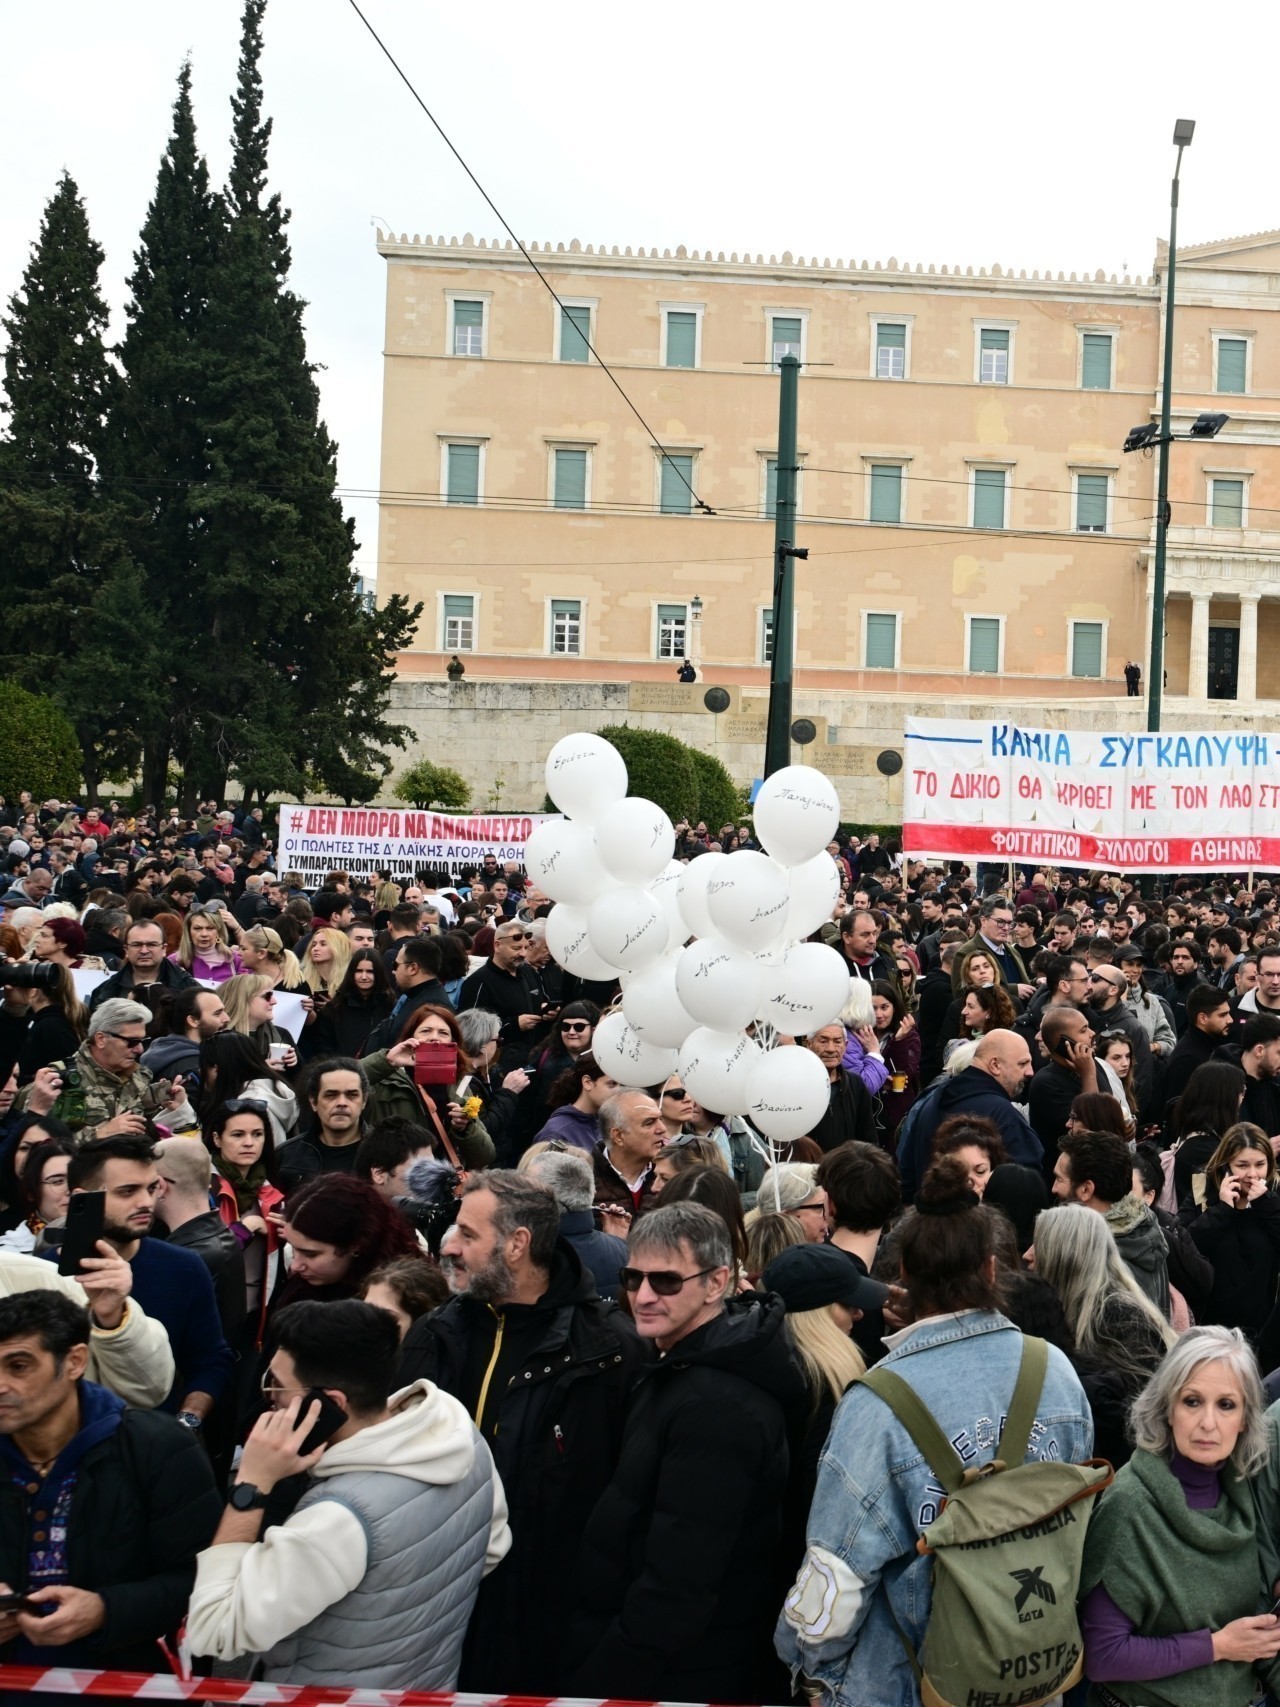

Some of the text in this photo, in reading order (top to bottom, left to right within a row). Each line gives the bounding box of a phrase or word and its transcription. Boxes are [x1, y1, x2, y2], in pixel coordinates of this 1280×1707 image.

[991, 725, 1268, 768] ΚΑΜΙΑ ΣΥΓΚΑΛΥΨΗ
[774, 788, 834, 812] Παναγιώτης
[912, 770, 938, 797] ΤΟ
[950, 773, 1001, 799] ΔΙΚΙΟ
[1018, 775, 1042, 800] ΘΑ
[1057, 782, 1112, 810] ΚΡΙΘΕΙ
[1130, 785, 1157, 810] ΜΕ
[1171, 785, 1208, 809] ΤΟΝ
[1219, 784, 1252, 809] ΛΑΟ
[305, 809, 338, 835] ΔΕΝ
[341, 811, 400, 838] ΜΠΟΡΩ
[404, 813, 428, 839] ΝΑ
[430, 814, 533, 842] ΑΝΑΠΝΕΥΣΩ
[285, 838, 298, 851] ΟΙ
[301, 839, 354, 854] ΠΩΛΗΤΕΣ
[357, 842, 380, 855] ΤΗΣ
[397, 841, 443, 857] ΛΑΪΚΗΣ
[446, 845, 495, 859] ΑΓΟΡΑΣ
[991, 831, 1262, 863] ΦΟΙΤΗΤΙΚΟΙ ΣΥΛΛΟΓΟΙ ΑΘΗΝΑΣ
[288, 854, 385, 873] ΣΥΜΠΑΡΑΣΤΕΚΟΝΤΑΙ
[385, 859, 412, 874] ΣΤΟΝ
[414, 860, 448, 875] ΔΙΚΑΙΟ
[770, 993, 814, 1012] Νικήτας
